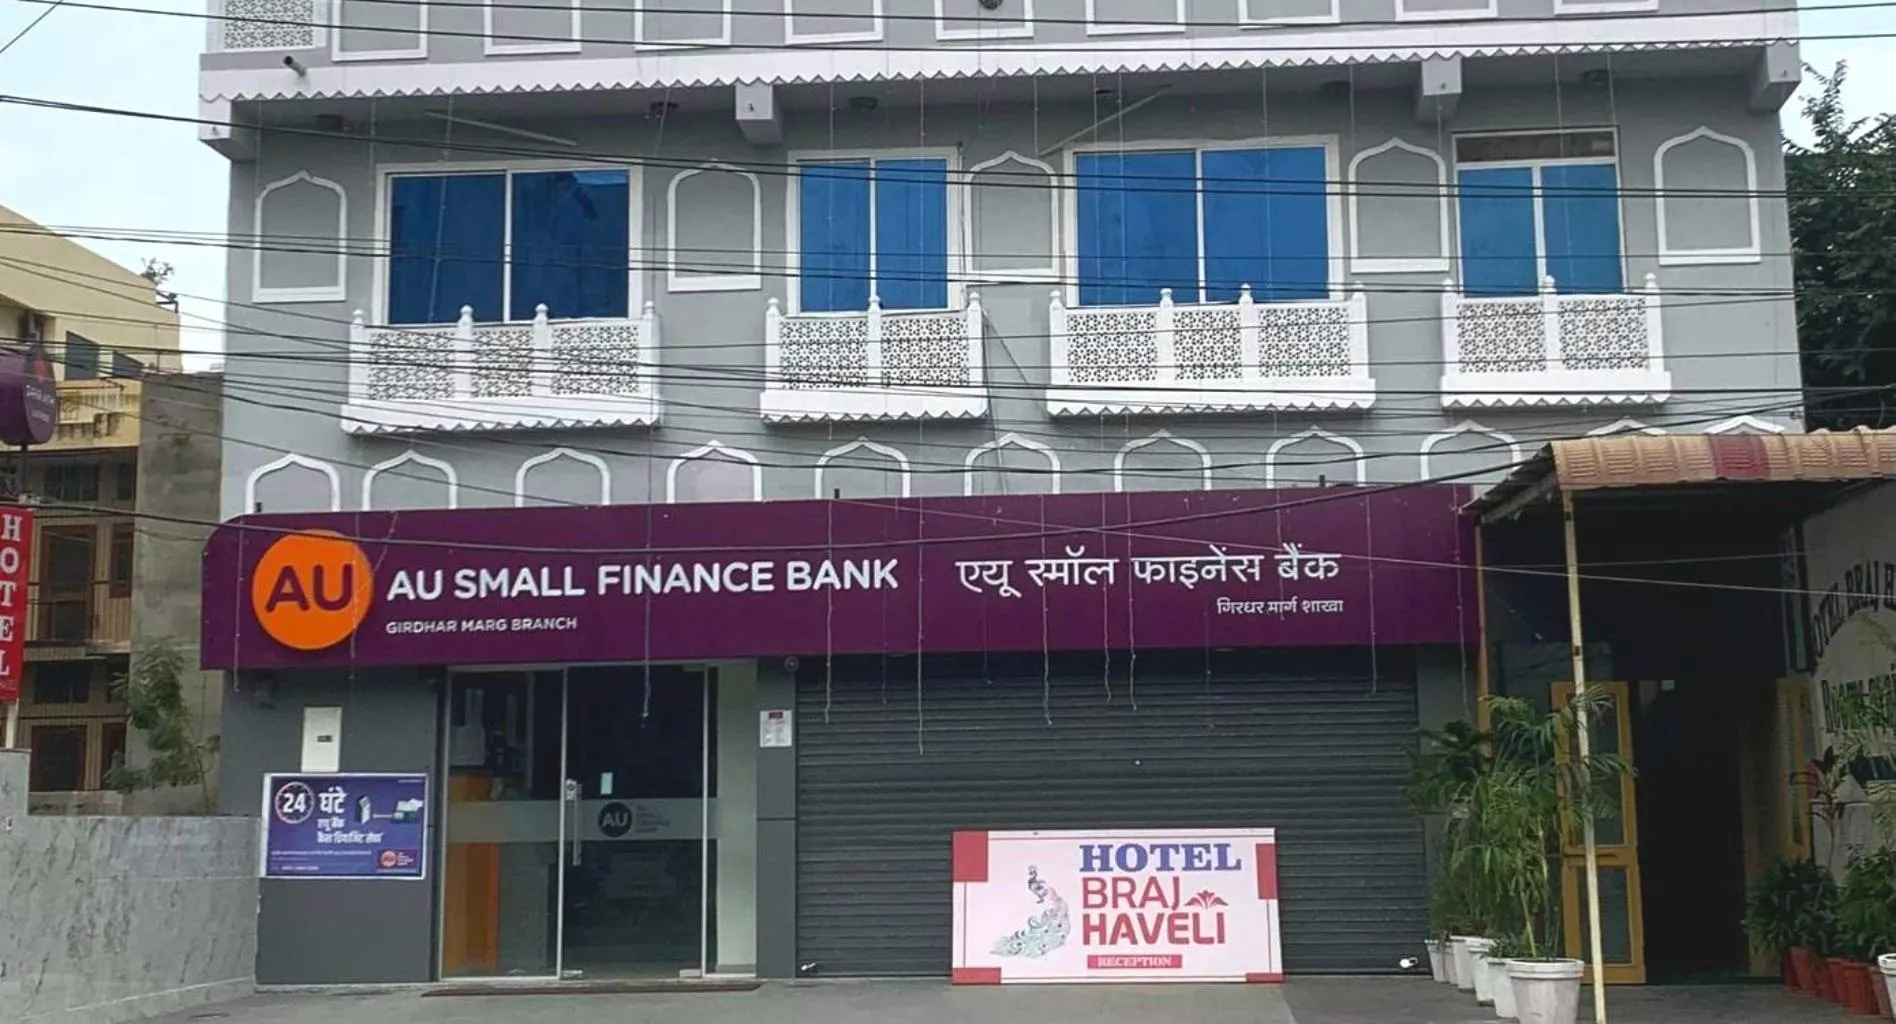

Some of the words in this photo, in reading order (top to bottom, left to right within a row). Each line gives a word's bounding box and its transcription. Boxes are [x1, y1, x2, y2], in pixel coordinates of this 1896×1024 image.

[387, 568, 443, 601] AU
[454, 566, 586, 599] SMALL
[598, 561, 775, 595] FINANCE
[786, 558, 899, 591] BANK
[956, 559, 1021, 598] एयू
[1025, 545, 1119, 588] स्मॉल
[1131, 544, 1265, 589] फाइनेंस
[1274, 542, 1342, 581] बैंक
[0, 513, 22, 677] HOTEL
[265, 564, 354, 613] AU
[1216, 597, 1265, 614] गिरधर
[1268, 596, 1298, 615] मार्ग
[1302, 597, 1344, 614] शाखा
[386, 619, 458, 635] GIRDHAR
[461, 618, 508, 633] MARG
[511, 616, 578, 632] BRANCH
[282, 792, 306, 813] 24
[601, 810, 630, 828] AU
[1079, 843, 1242, 873] HOTEL
[1082, 876, 1180, 911] BRAJ
[1082, 911, 1226, 946] HAVELI
[1097, 955, 1173, 968] RECEPTION
